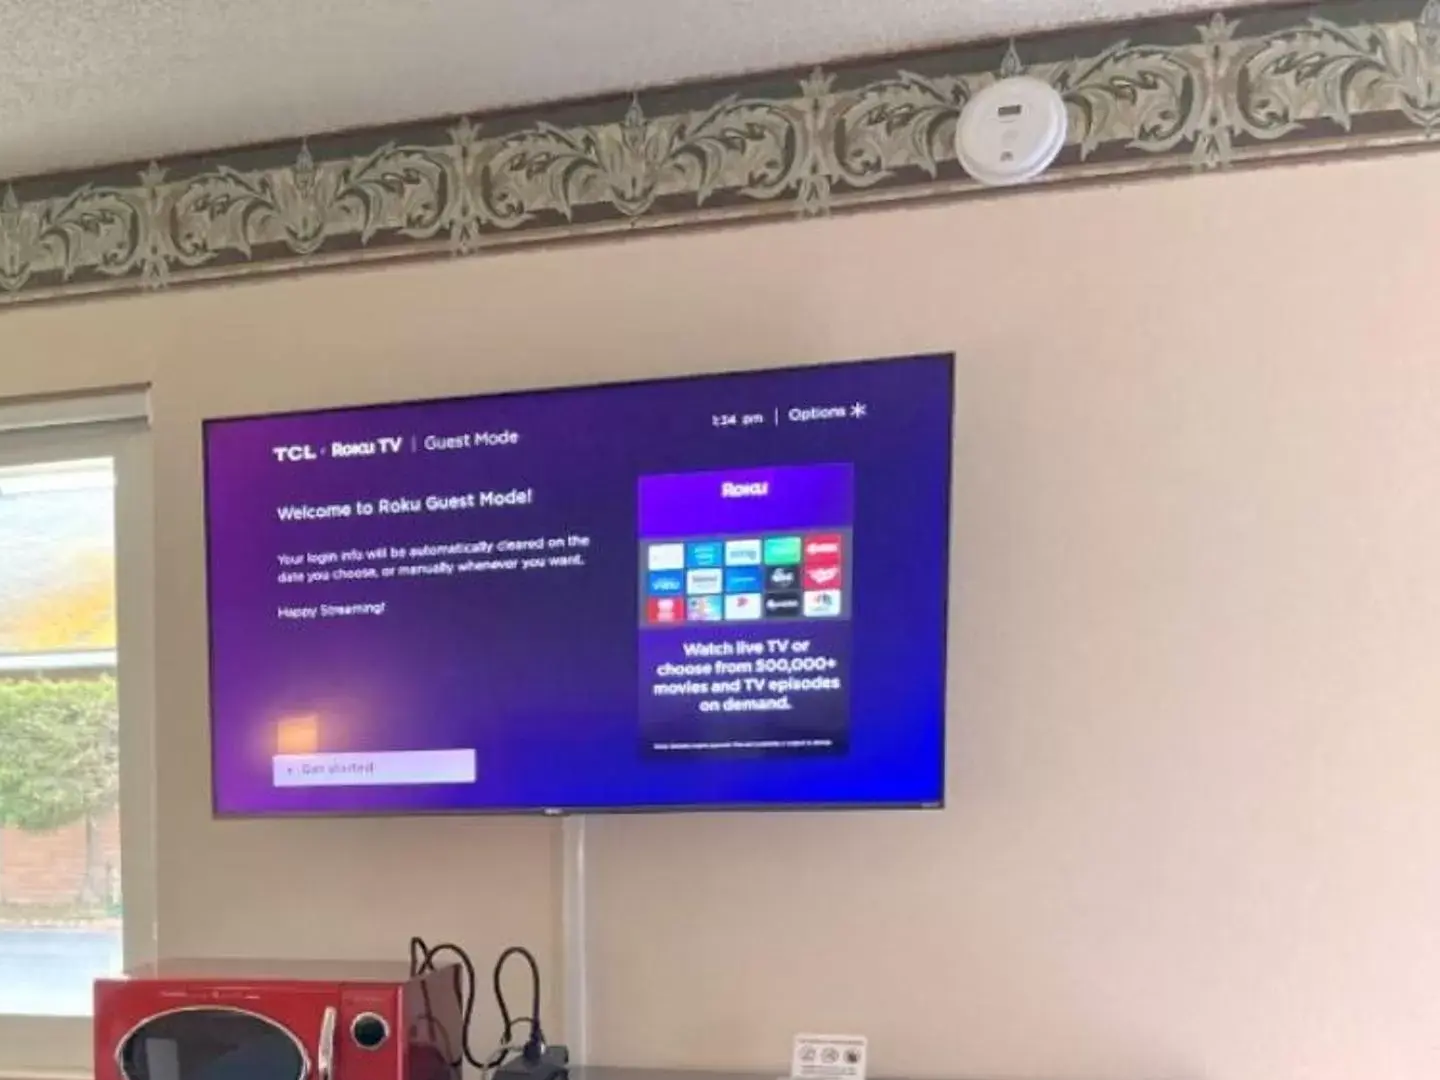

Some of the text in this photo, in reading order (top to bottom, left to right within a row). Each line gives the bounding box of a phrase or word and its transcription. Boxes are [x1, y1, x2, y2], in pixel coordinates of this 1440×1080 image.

[742, 413, 763, 426] pm
[788, 406, 846, 422] Options
[424, 429, 520, 450] Guest Mode
[272, 437, 403, 462] TCL Roku TV
[277, 488, 534, 521] Welcome to Roku Guest Mode!
[277, 534, 590, 565] Your login info will be automatically cleared on the
[277, 570, 305, 583] date
[307, 571, 330, 583] you
[381, 566, 396, 577] or
[398, 561, 454, 575] manually
[458, 559, 518, 572] whenever
[521, 557, 546, 570] you
[277, 602, 385, 619] Happy Streaming!
[683, 638, 810, 656] Watch live TV or
[656, 656, 836, 676] choose from 500,000+
[653, 676, 841, 695] movies and TV episodes
[698, 695, 792, 713] on demand.
